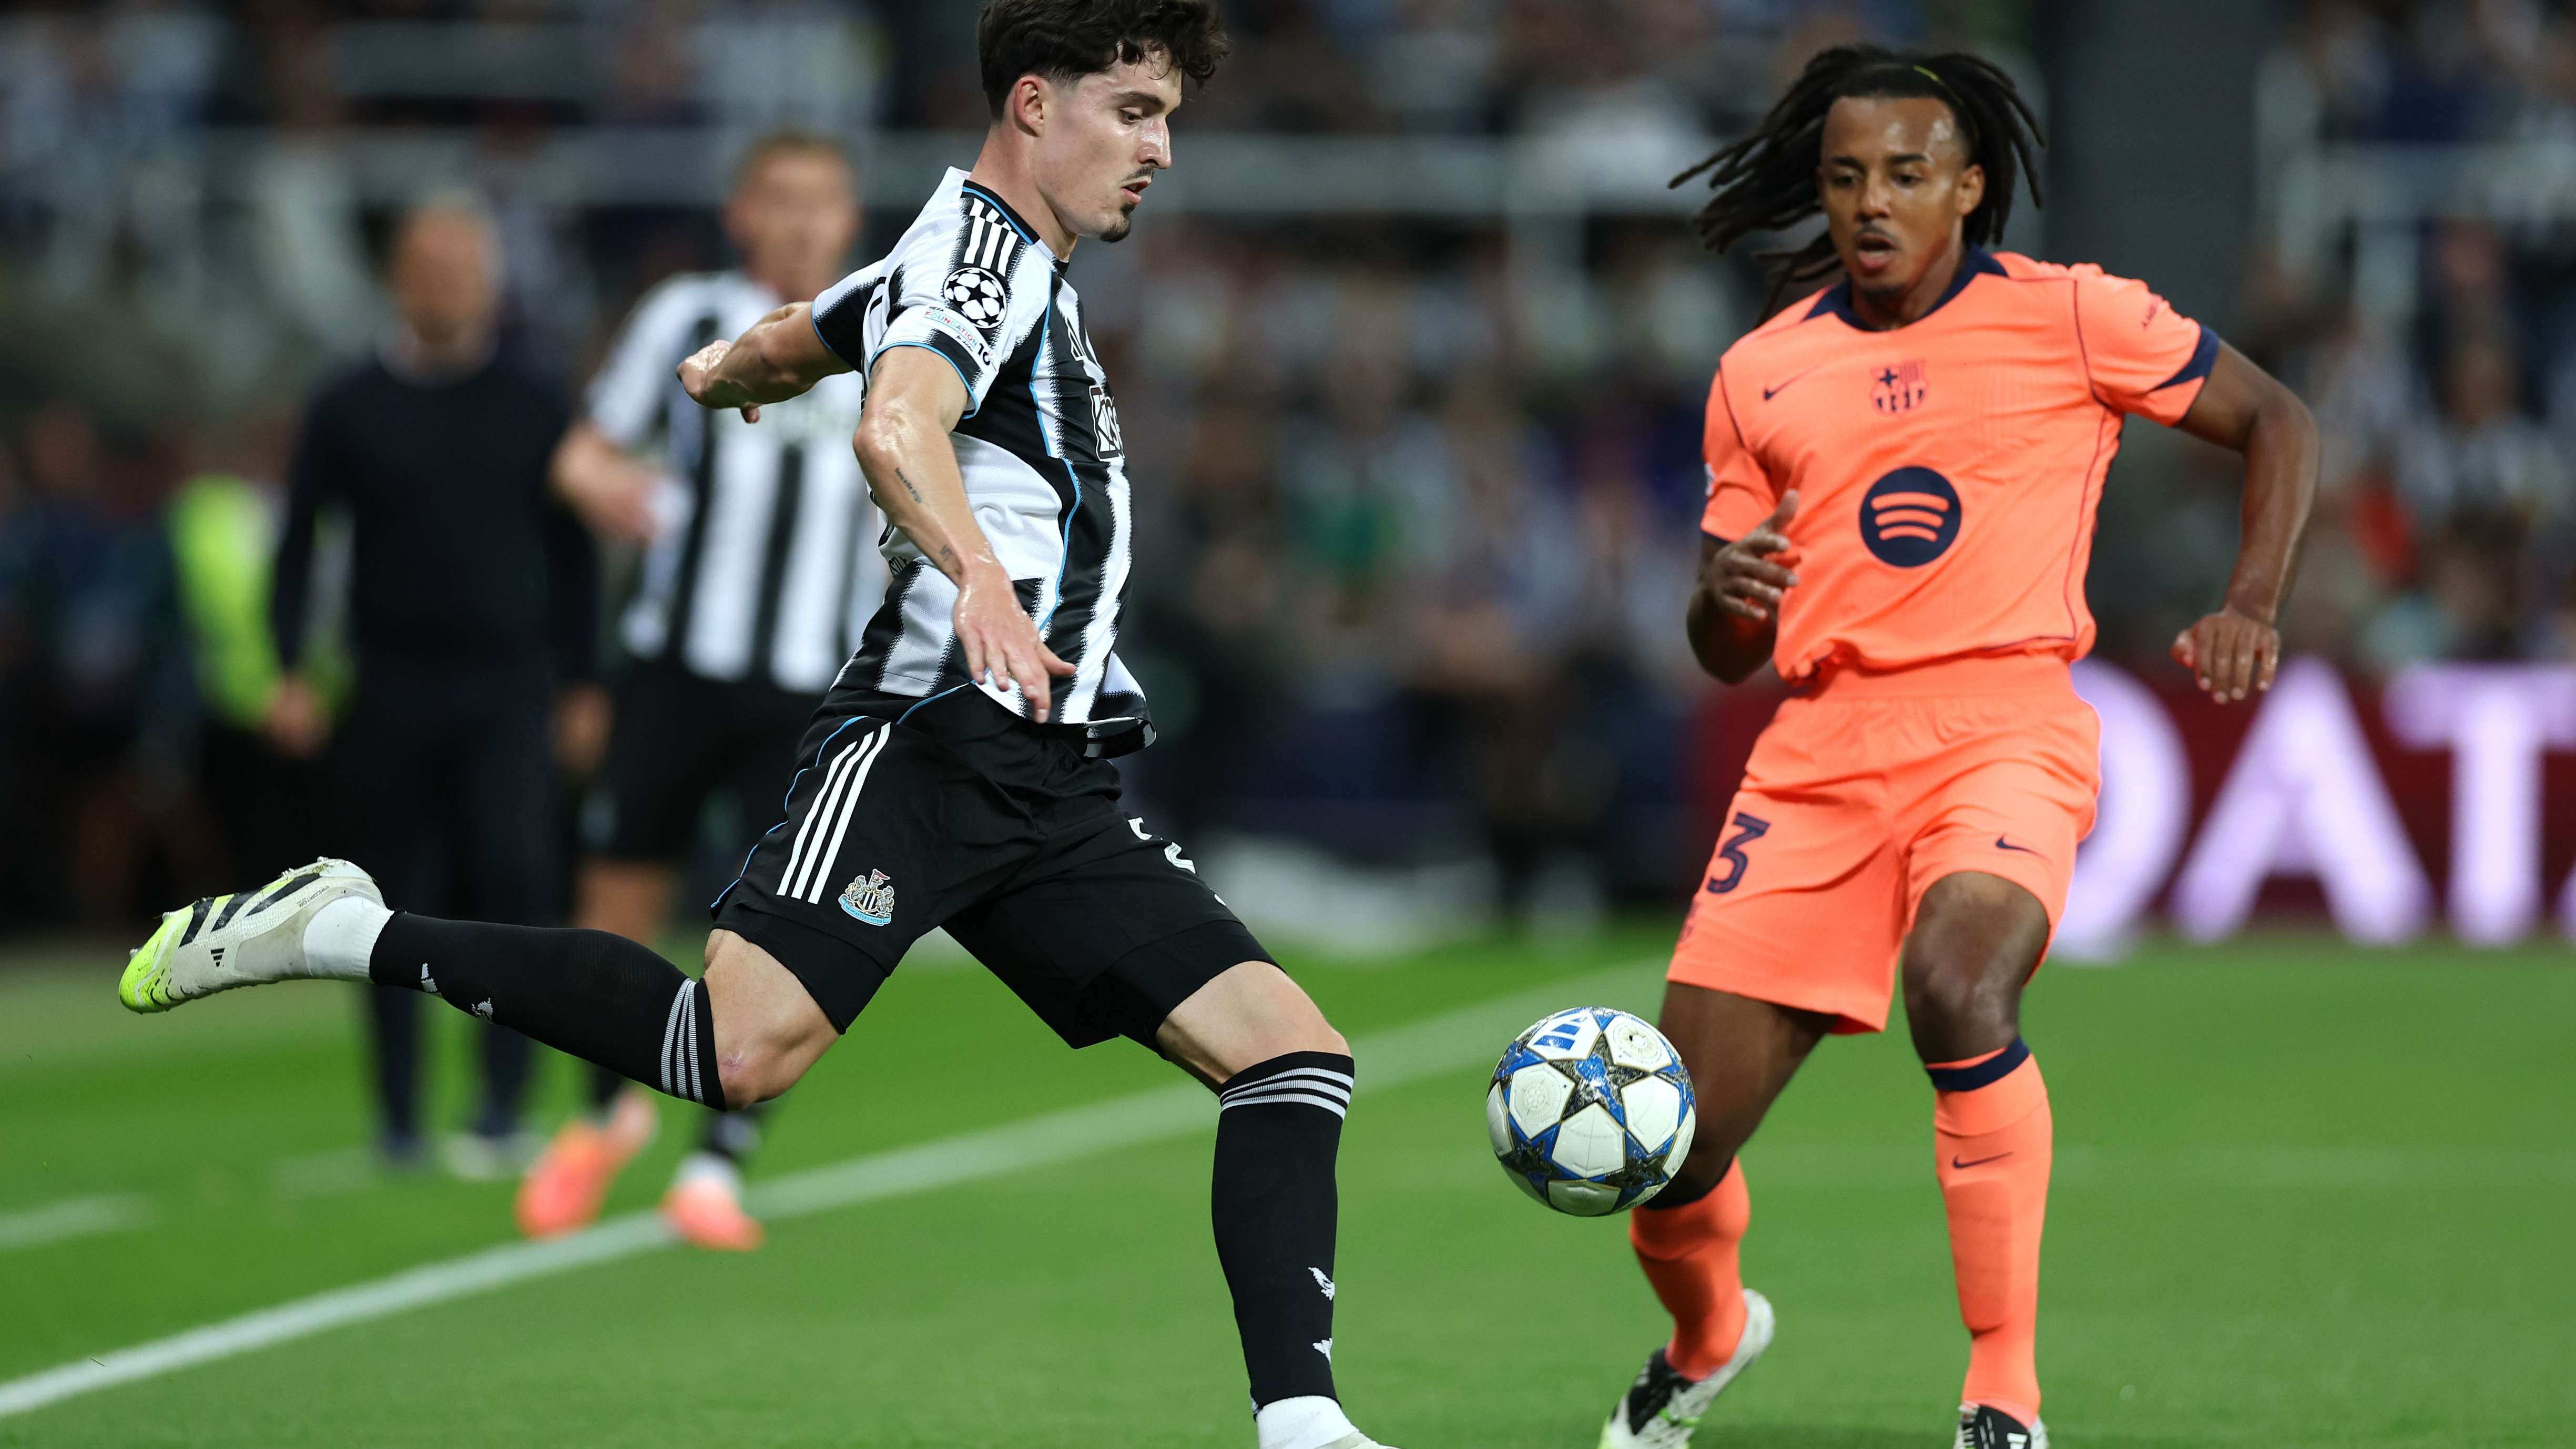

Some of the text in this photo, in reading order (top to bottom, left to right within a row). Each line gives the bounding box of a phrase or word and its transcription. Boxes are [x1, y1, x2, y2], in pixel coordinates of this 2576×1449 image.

[925, 311, 978, 346] FOUNDATION
[1707, 811, 1770, 894] 3
[846, 905, 867, 919] NEWCASTLE
